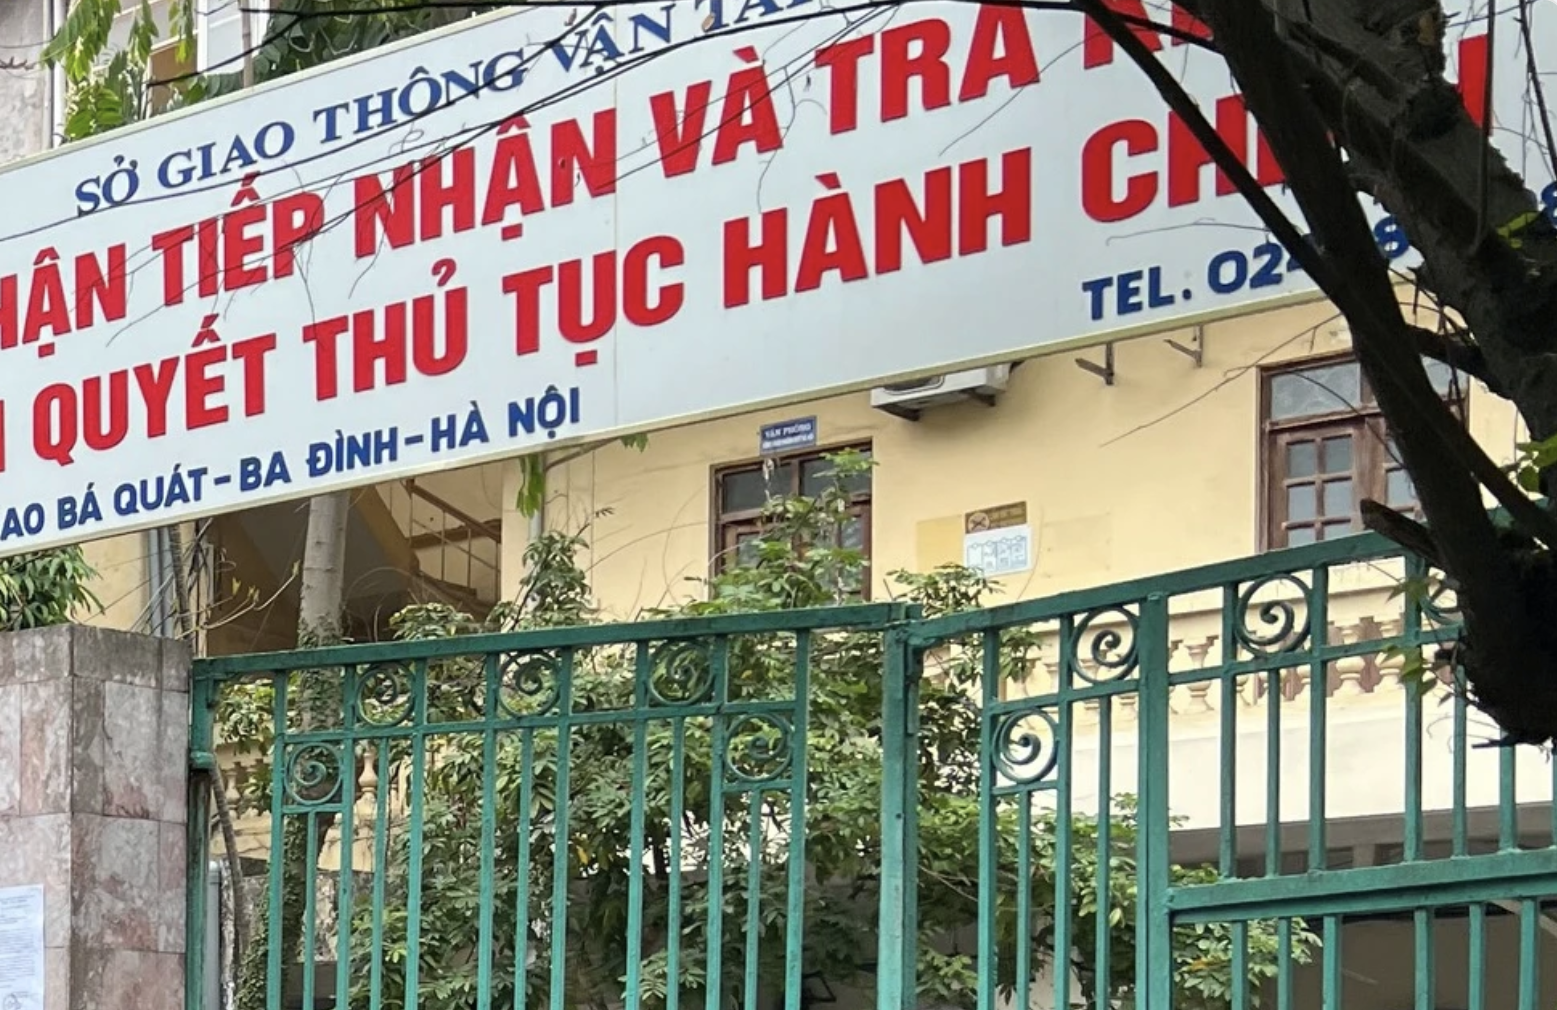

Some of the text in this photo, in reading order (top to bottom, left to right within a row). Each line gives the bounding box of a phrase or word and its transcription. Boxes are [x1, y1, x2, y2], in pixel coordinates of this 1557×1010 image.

[75, 156, 140, 217] SỞ
[157, 121, 295, 189] GIAO
[313, 48, 529, 143] THÔNG
[549, 3, 676, 76] VẬN
[152, 171, 324, 304] TIẾP
[354, 107, 617, 257] NHẬN
[649, 45, 784, 179] VÀ
[32, 314, 276, 466] QUYẾT
[302, 258, 467, 402] THỦ
[502, 235, 684, 366] TỤC
[723, 147, 1032, 309] HÀNH
[56, 481, 103, 530] BÁ
[507, 384, 581, 439] NỘI
